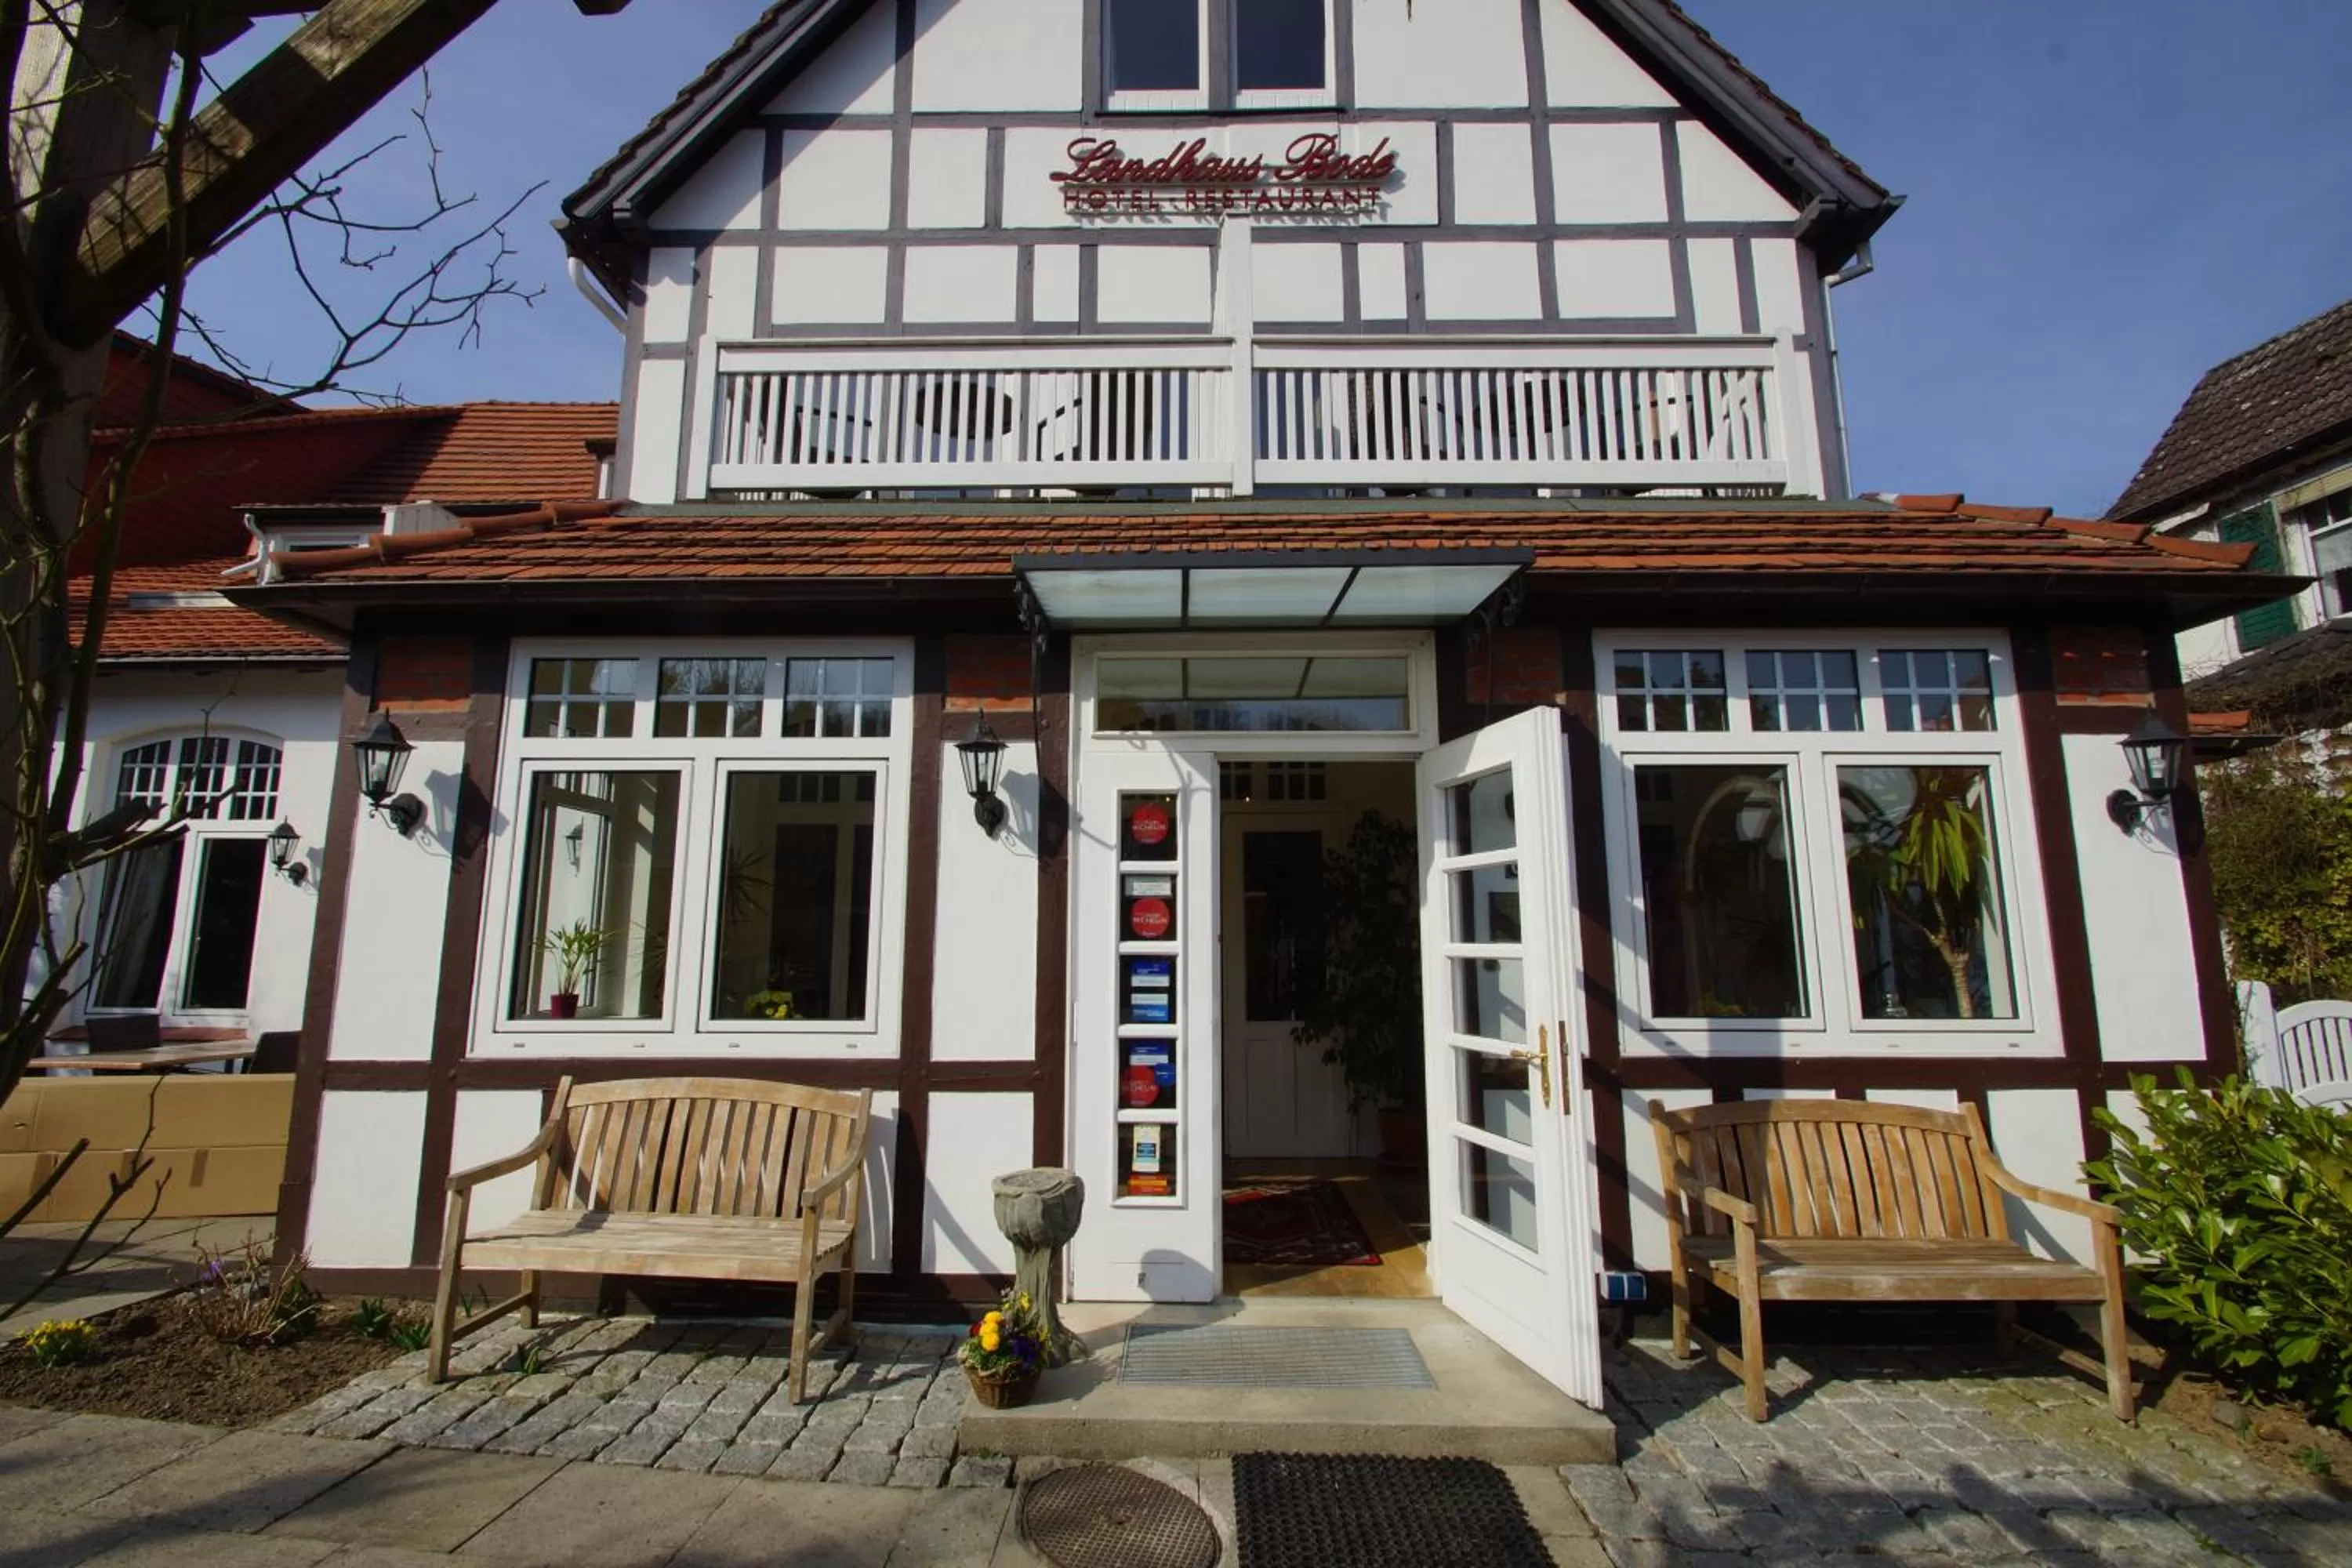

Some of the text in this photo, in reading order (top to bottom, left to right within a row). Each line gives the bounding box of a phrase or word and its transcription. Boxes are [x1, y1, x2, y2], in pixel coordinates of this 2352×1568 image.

[1049, 132, 1395, 182] Landhaus Bode
[1064, 188, 1160, 209] HOTEL
[1185, 187, 1381, 209] RESTAURANT
